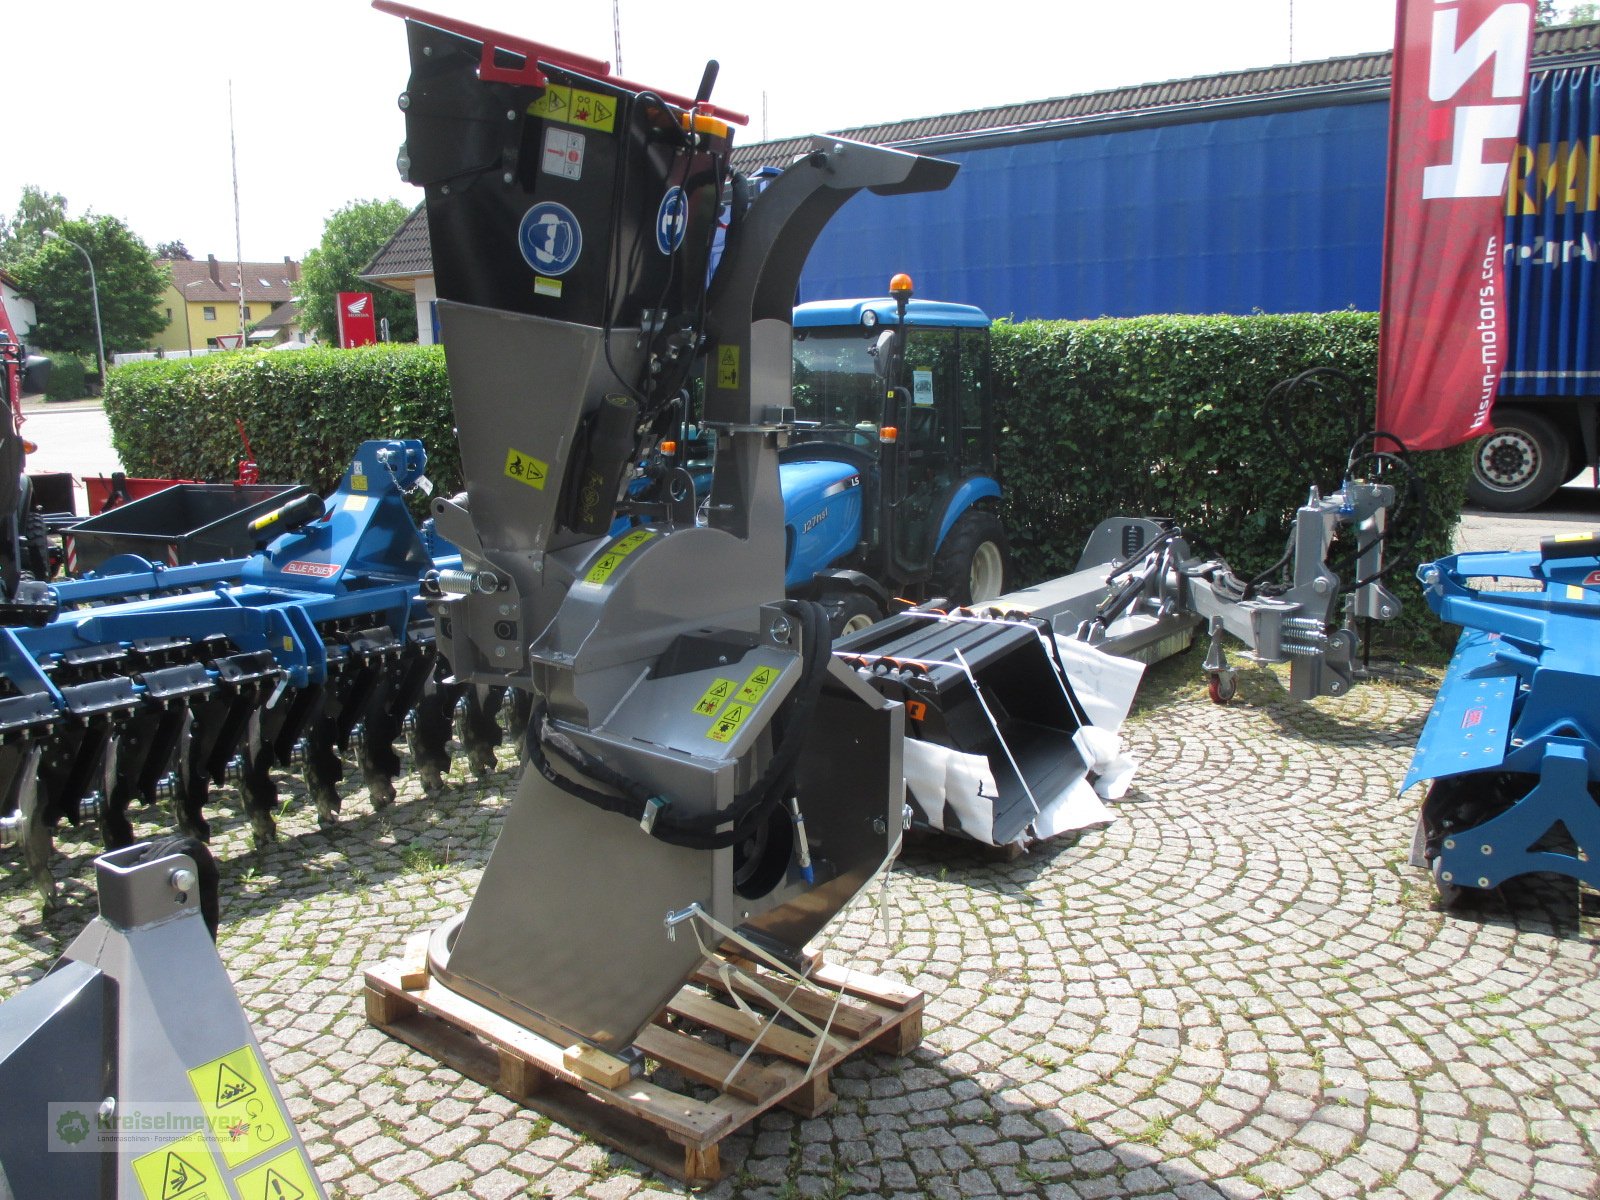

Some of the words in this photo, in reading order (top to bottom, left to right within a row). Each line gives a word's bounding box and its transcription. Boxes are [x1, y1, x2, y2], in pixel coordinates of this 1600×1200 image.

[1470, 235, 1496, 429] hisun-motors.com
[851, 477, 860, 487] LS
[288, 563, 308, 573] BLUE
[308, 565, 333, 575] POWER
